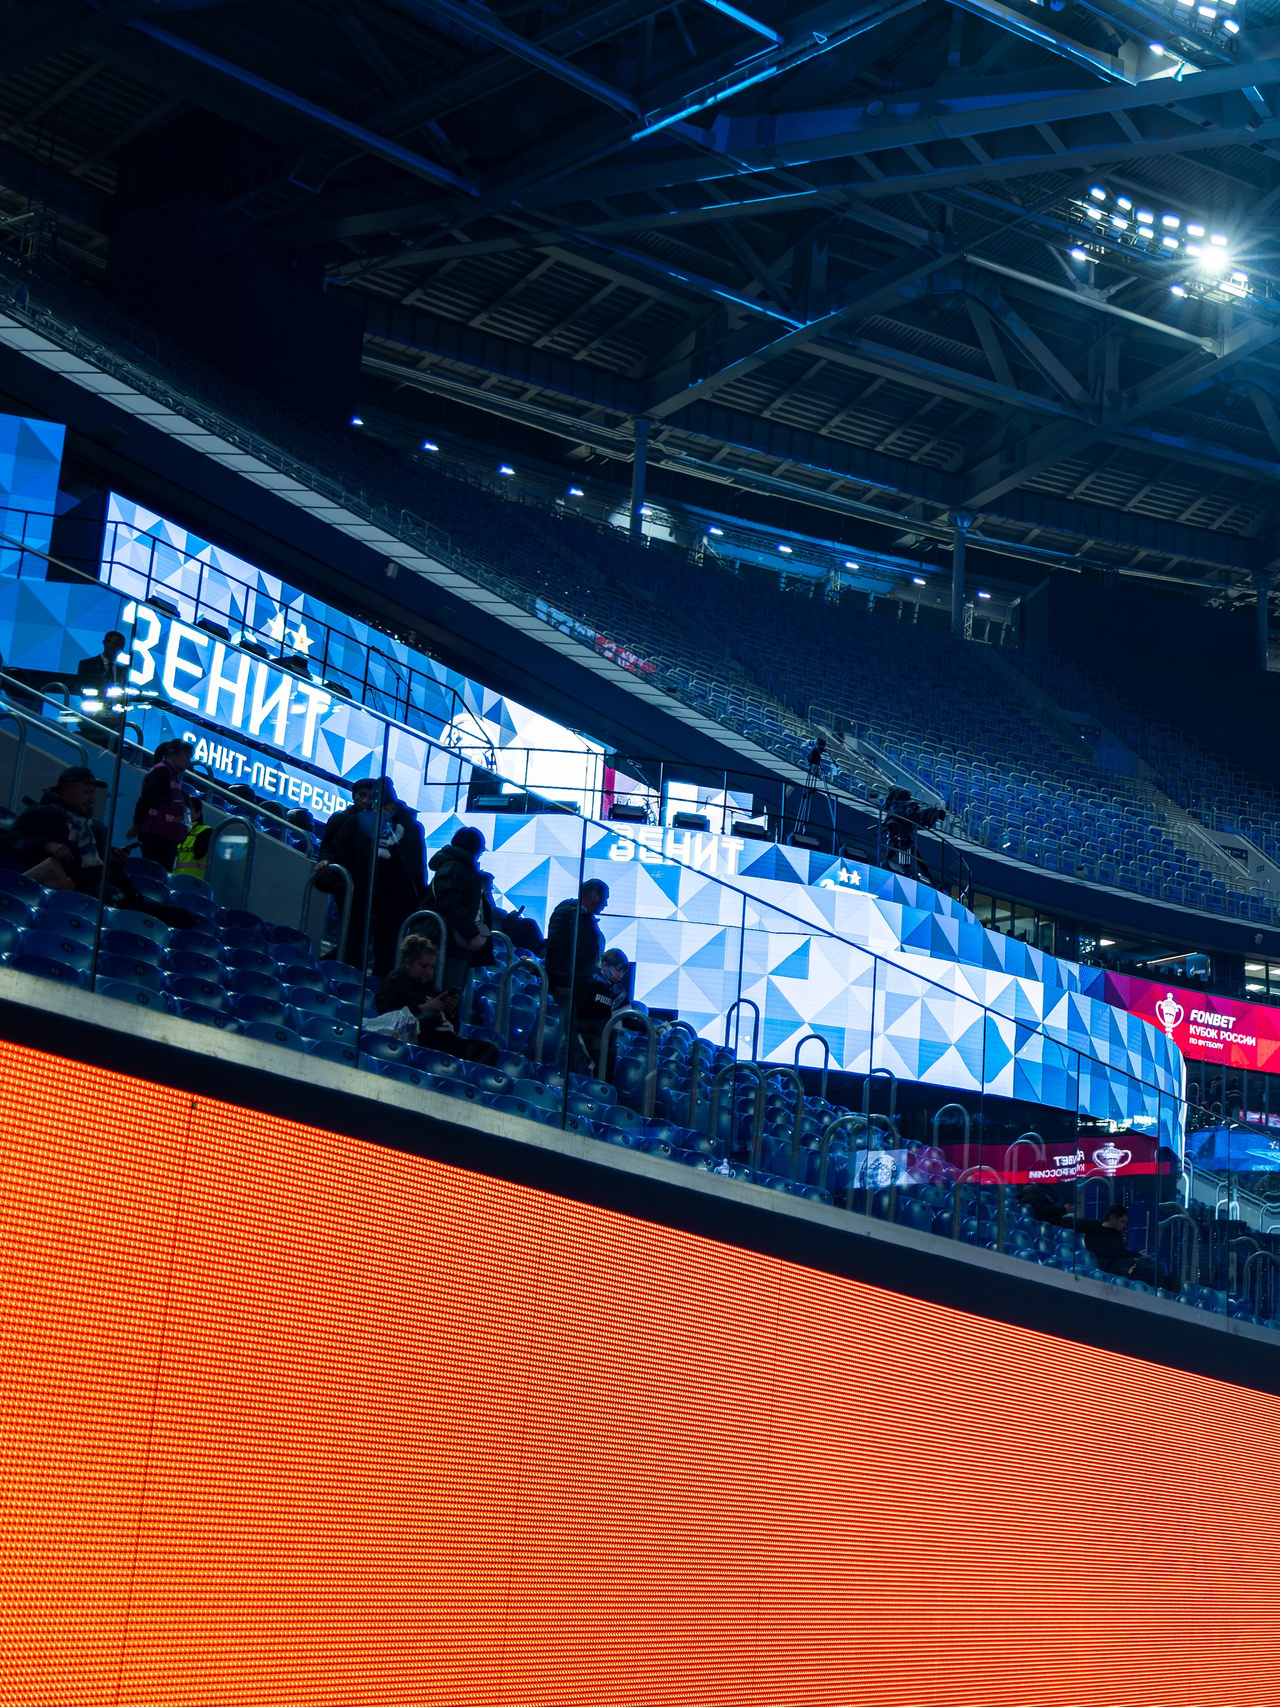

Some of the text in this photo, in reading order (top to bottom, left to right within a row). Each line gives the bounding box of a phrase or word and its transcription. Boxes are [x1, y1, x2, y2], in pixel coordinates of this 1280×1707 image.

[117, 601, 332, 759] ЗЕНИТ
[183, 731, 354, 815] САНКТ-ПЕТЕРБУР
[594, 993, 611, 1006] PUM
[1189, 1009, 1236, 1029] FONBET
[1189, 1024, 1256, 1047] КУБОК РОССИИ
[1198, 1039, 1224, 1050] ФУТБОЛУ
